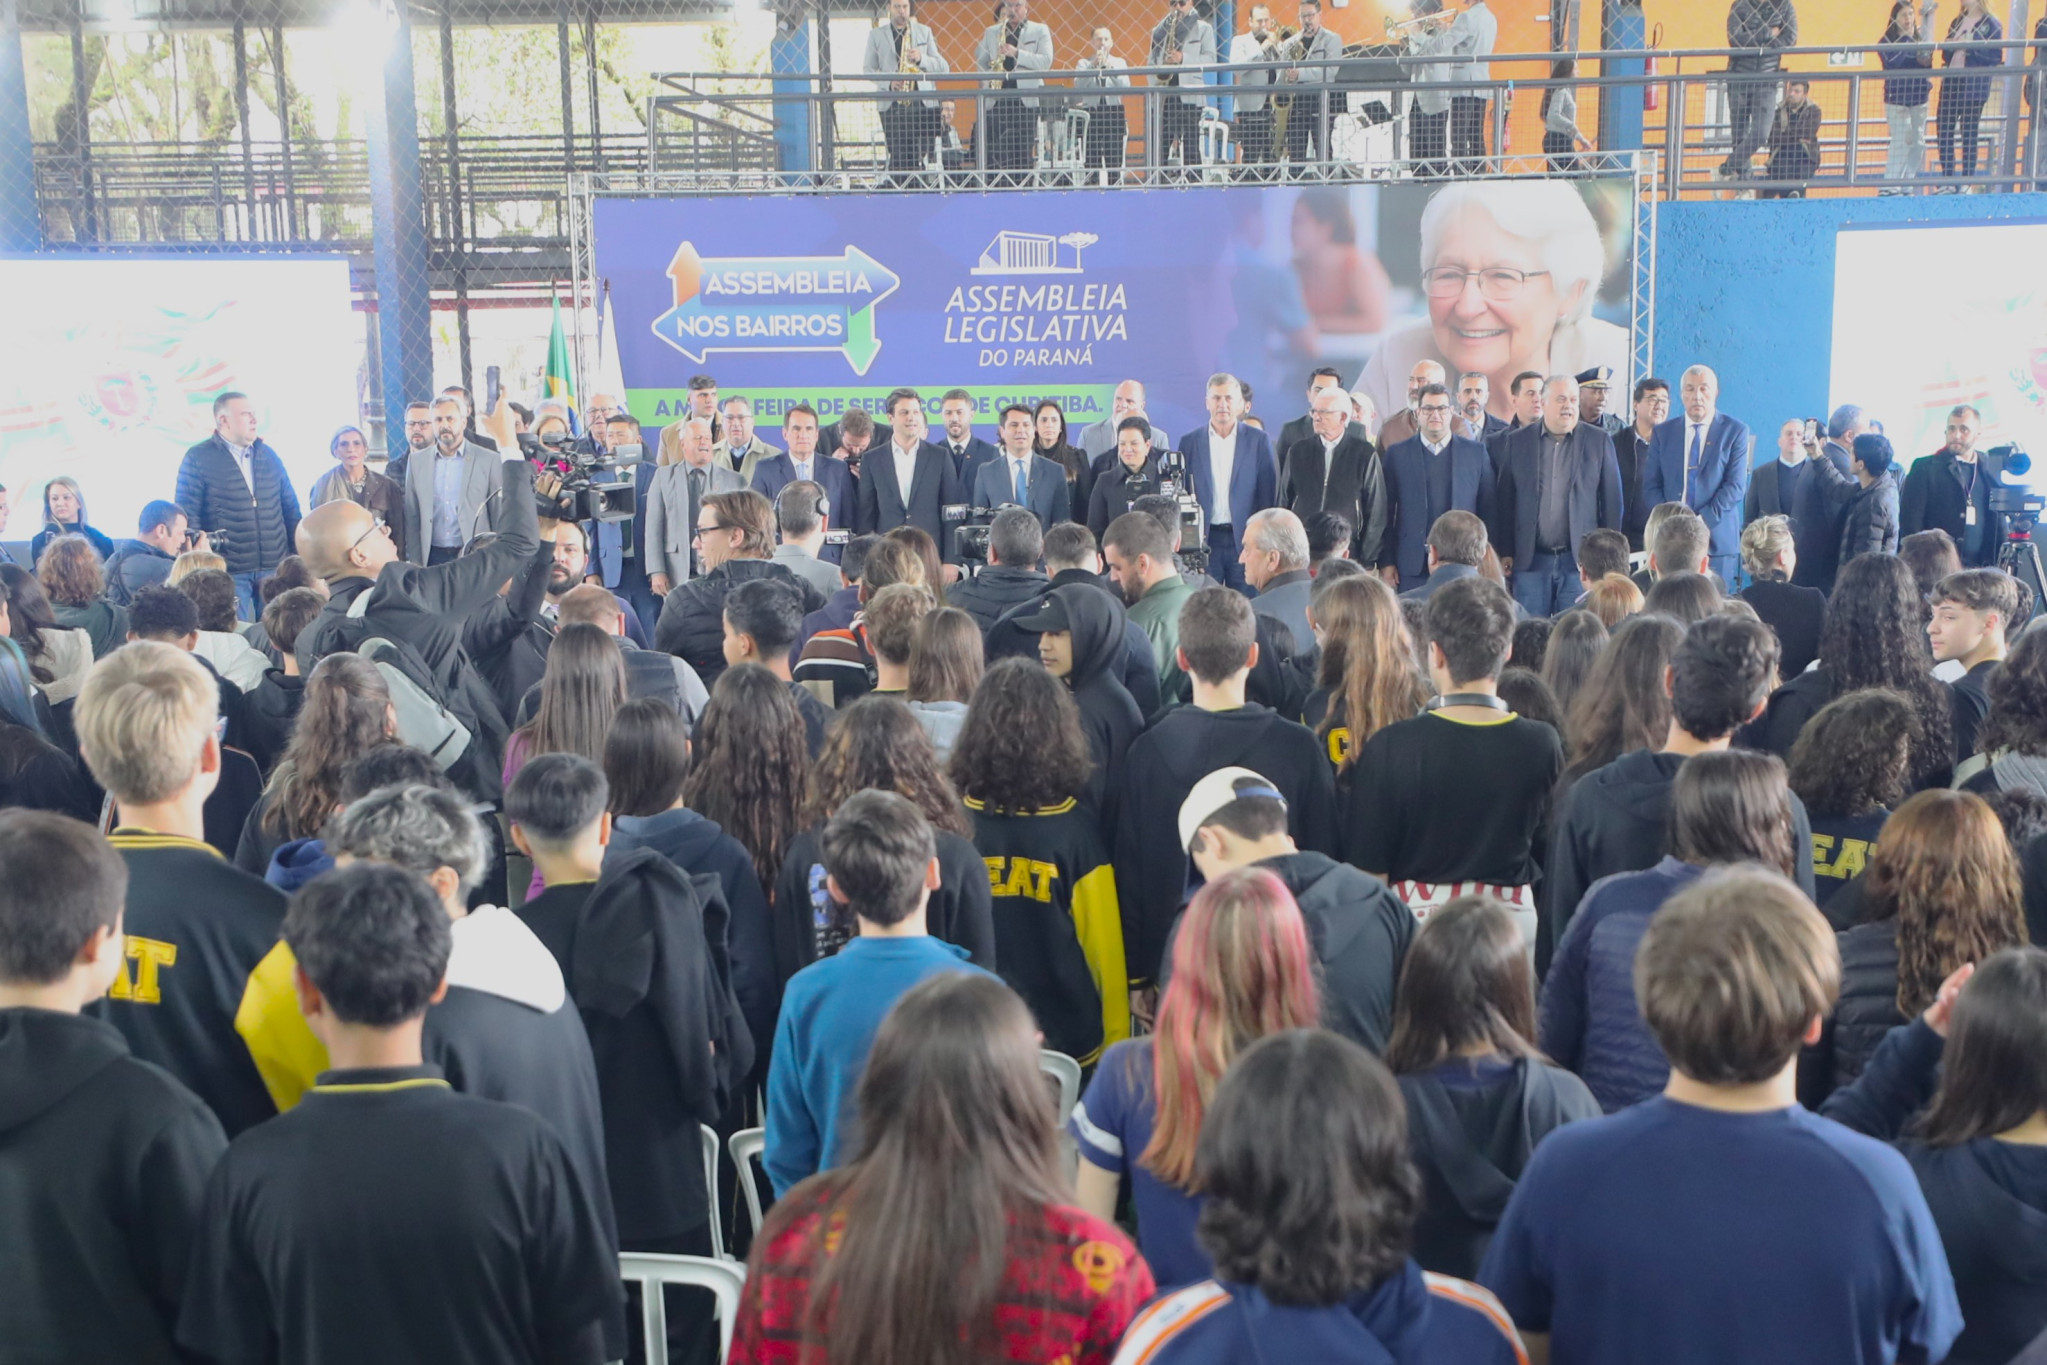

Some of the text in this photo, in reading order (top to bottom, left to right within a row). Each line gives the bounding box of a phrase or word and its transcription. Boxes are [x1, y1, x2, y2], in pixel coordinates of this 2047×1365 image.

[705, 270, 873, 295] ASSEMBLEIA
[944, 283, 1128, 313] ASSEMBLEIA
[676, 314, 843, 337] NOS BAIRROS
[944, 314, 1128, 343] LEGISLATIVA
[979, 343, 1093, 367] DO PARANÁ
[655, 399, 671, 416] A
[817, 398, 845, 415] DE
[1811, 833, 1878, 879] EA
